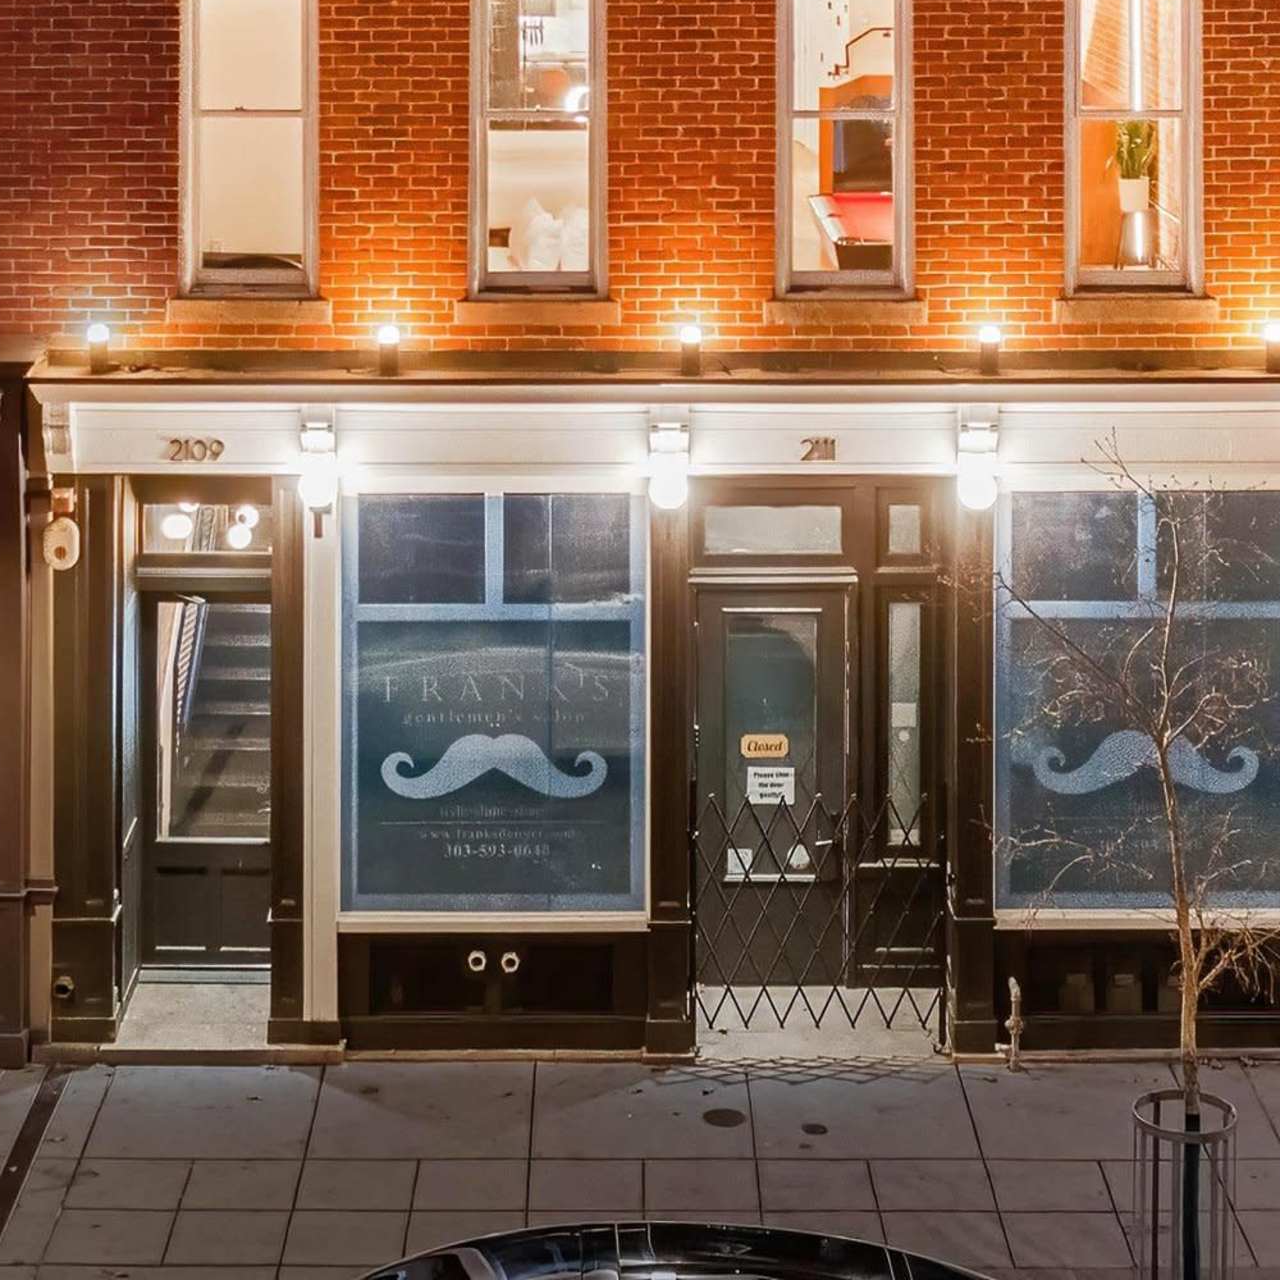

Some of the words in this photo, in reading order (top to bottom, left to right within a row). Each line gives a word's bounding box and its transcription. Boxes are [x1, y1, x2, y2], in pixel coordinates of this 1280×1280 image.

[167, 438, 224, 461] 2109
[800, 438, 837, 461] 2111
[383, 671, 610, 703] FRANK'S
[747, 740, 784, 753] Closed
